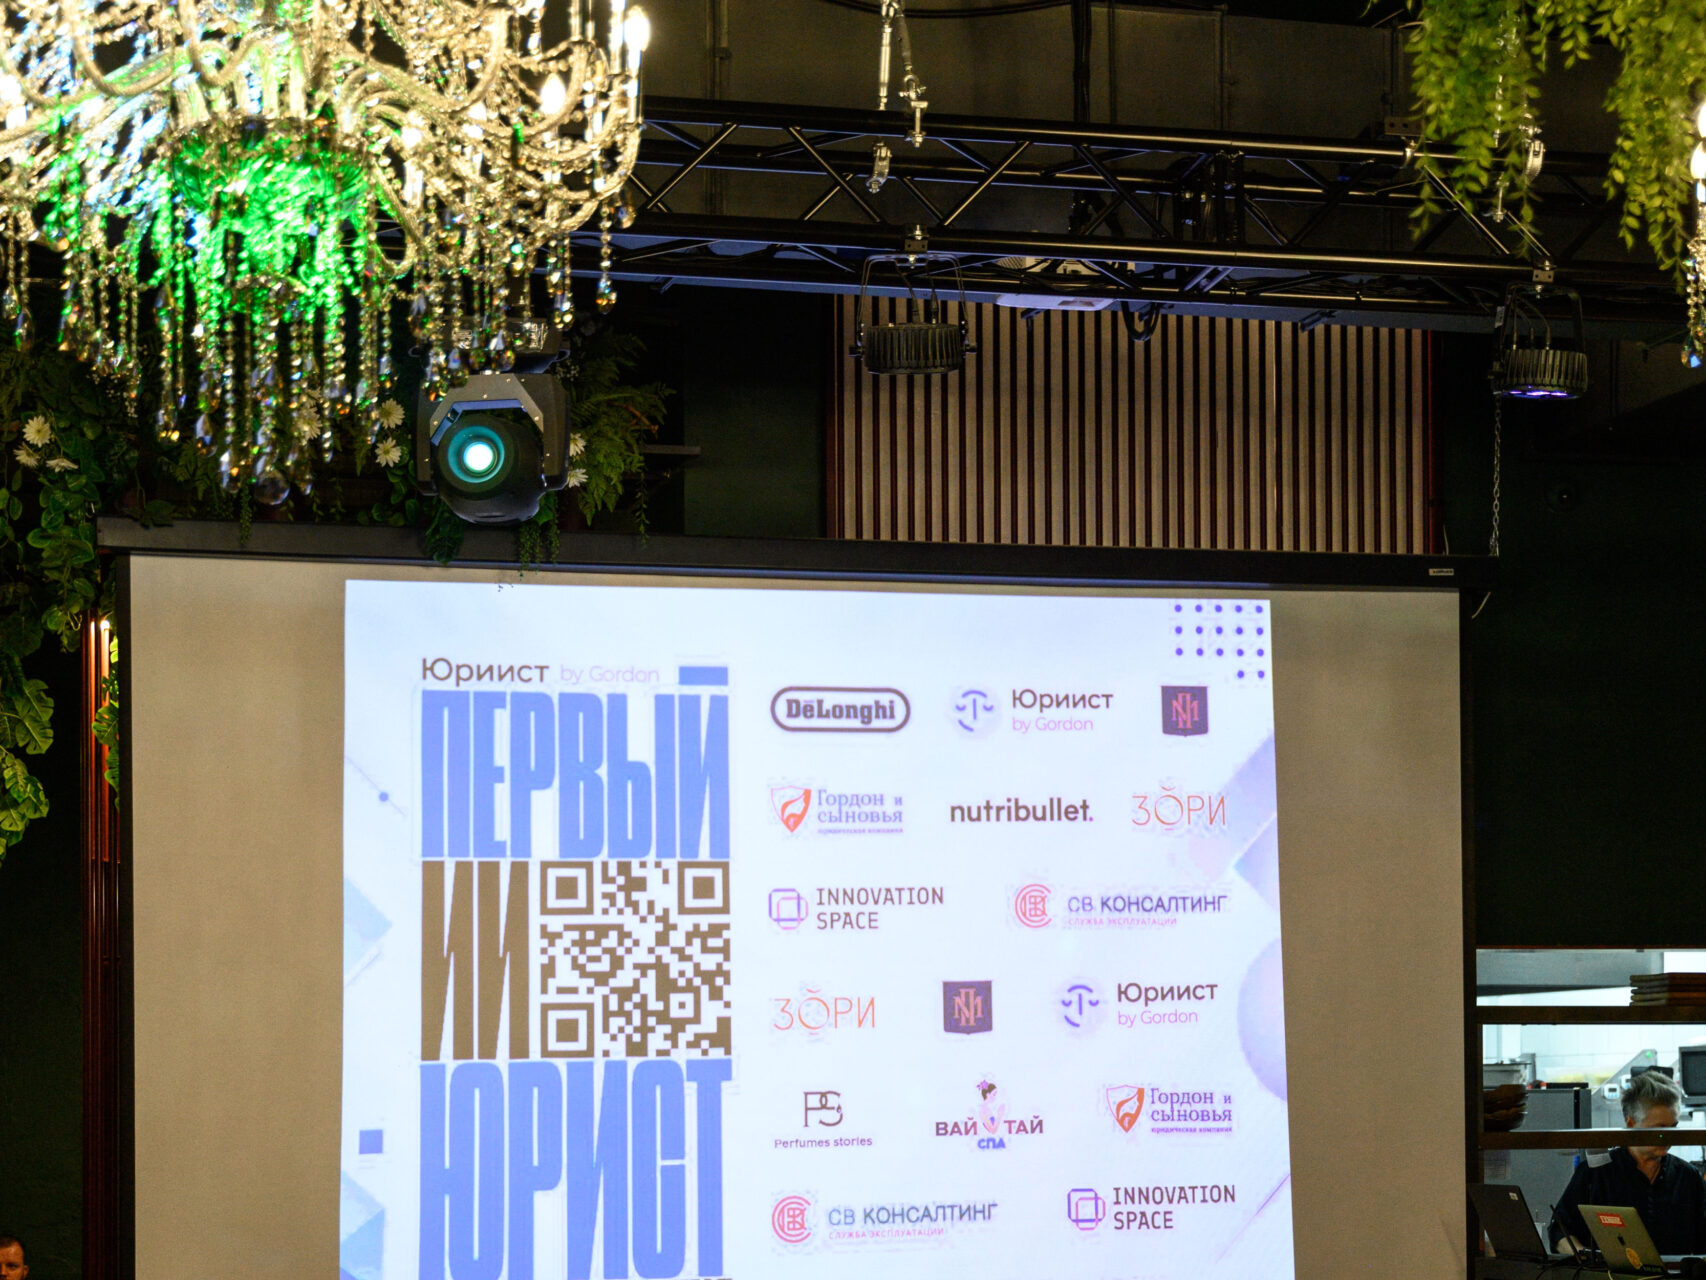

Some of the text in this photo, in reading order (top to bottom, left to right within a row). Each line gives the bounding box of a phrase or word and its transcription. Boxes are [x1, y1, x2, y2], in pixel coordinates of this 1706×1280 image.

[422, 657, 660, 688] Юриист by Gordon
[1012, 688, 1114, 713] Юриист
[1012, 716, 1094, 734] by Gordon
[420, 666, 731, 860] ПЕРВЫЙ
[817, 788, 903, 811] Гордон и
[817, 810, 903, 824] сыновья
[816, 886, 945, 906] INNOVATION
[1100, 895, 1228, 913] КОНСАЛТИНГ
[816, 911, 880, 930] SPACE
[1117, 982, 1218, 1007] Юриист
[1117, 1009, 1198, 1028] by Gordon
[1150, 1087, 1232, 1111] Гордон и
[935, 1115, 1043, 1136] ВАЙ ТАЙ
[1150, 1109, 1232, 1122] сыновья
[774, 1136, 873, 1149] Perfumes stories
[1112, 1184, 1236, 1205] INNOVATION
[862, 1203, 999, 1225] КОНСАЛТИНГ
[1113, 1210, 1174, 1230] SPACE
